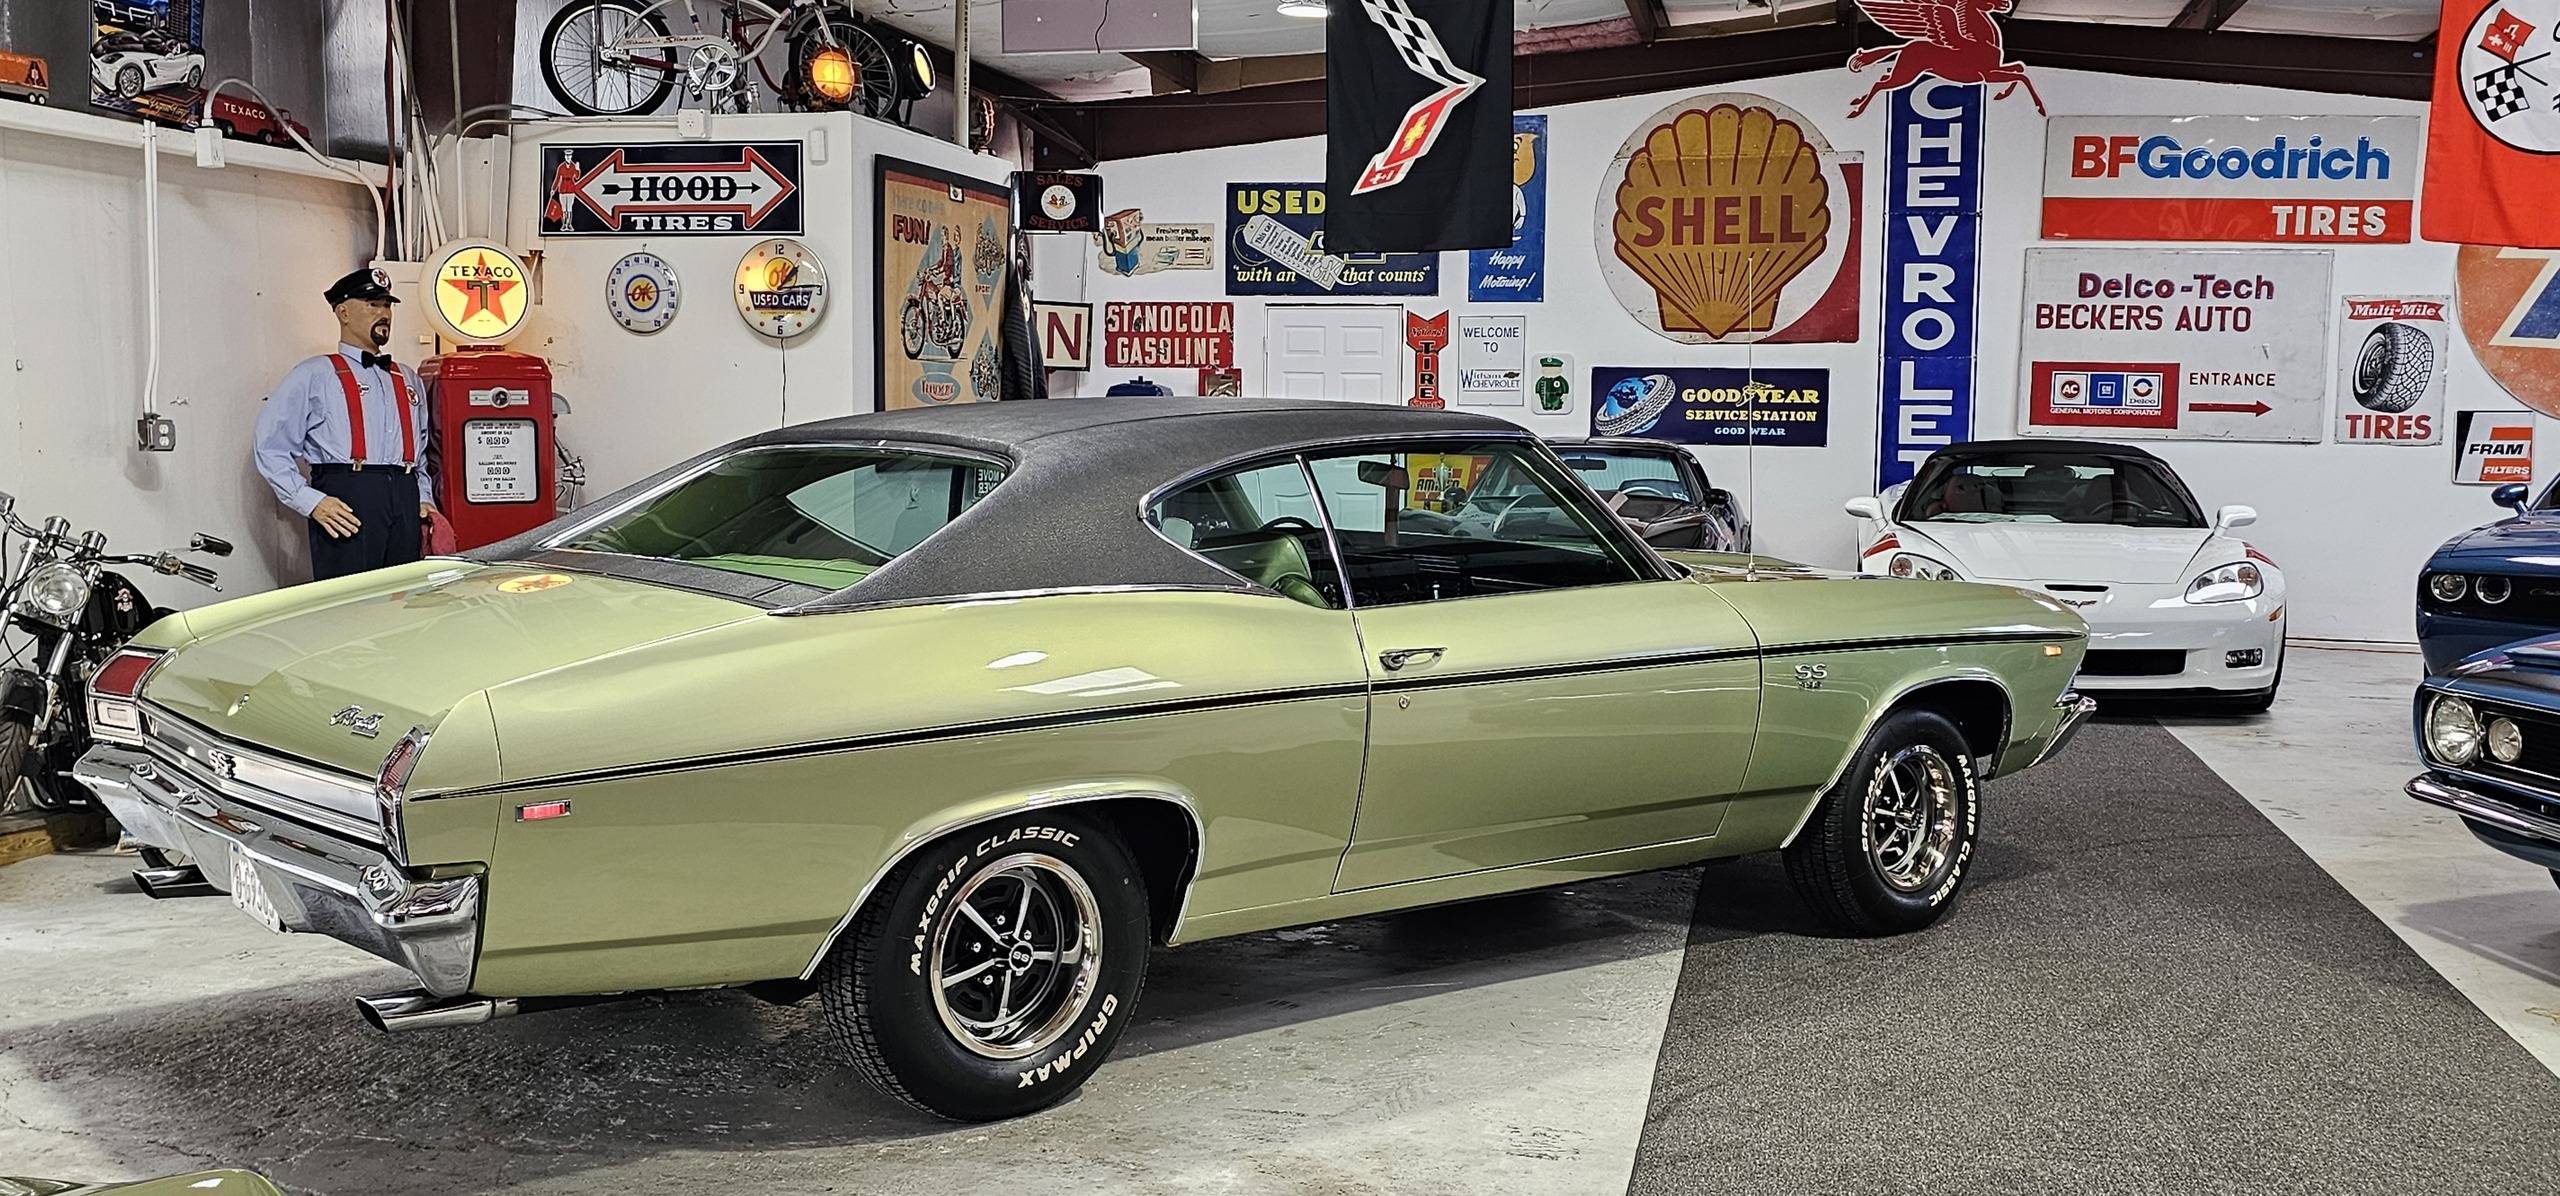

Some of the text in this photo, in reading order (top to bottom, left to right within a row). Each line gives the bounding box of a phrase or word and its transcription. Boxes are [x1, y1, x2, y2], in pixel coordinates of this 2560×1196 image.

[223, 102, 266, 119] TEXACO
[2071, 134, 2390, 180] BFGoodrich
[1035, 174, 1084, 187] SALES
[629, 176, 737, 202] HOOD
[1237, 190, 1326, 214] USED
[630, 216, 733, 231] TIRES
[1028, 214, 1089, 230] SERVICE
[1632, 194, 1807, 248] SHELL
[2271, 205, 2387, 237] TIRES
[892, 213, 931, 246] FUN!
[775, 244, 784, 255] 12
[1488, 250, 1526, 270] Happy
[450, 265, 513, 278] TEXACO
[1276, 270, 1296, 283] an
[1342, 268, 1374, 283] that
[738, 283, 745, 295] 9
[1478, 272, 1537, 292] Motoring!
[816, 285, 823, 296] 3
[752, 293, 809, 307] USED CARS
[2035, 303, 2252, 332] BECKERS AUTO
[2352, 304, 2437, 317] Multi-Mile
[1106, 304, 1232, 333] STANOCOLA
[777, 325, 784, 335] 6
[1463, 326, 1520, 338] WELCOME
[1116, 336, 1222, 366] GASOLINE
[1483, 341, 1499, 353] TO
[1418, 340, 1436, 399] TIRE
[1472, 379, 1521, 388] CHEVROLET
[2189, 372, 2277, 387] ENTRANCE
[2061, 384, 2079, 395] AC
[1685, 409, 1818, 422] SERVICE STATION
[2113, 408, 2162, 416] CORPORATION
[1714, 426, 1786, 436] GOOD WEAR
[2344, 414, 2432, 440] TIRES
[2468, 443, 2525, 455] FRAM
[2483, 465, 2530, 475] FILTERS
[1794, 662, 1828, 680] SS
[208, 749, 229, 771] SS
[1956, 754, 1976, 836] MAXGRIP
[1928, 840, 1971, 907] CLASSIC
[909, 825, 1081, 976] MAXGRIP CLASSIC
[1012, 950, 1030, 963] SS
[1017, 993, 1119, 1089] GRIPMAX
